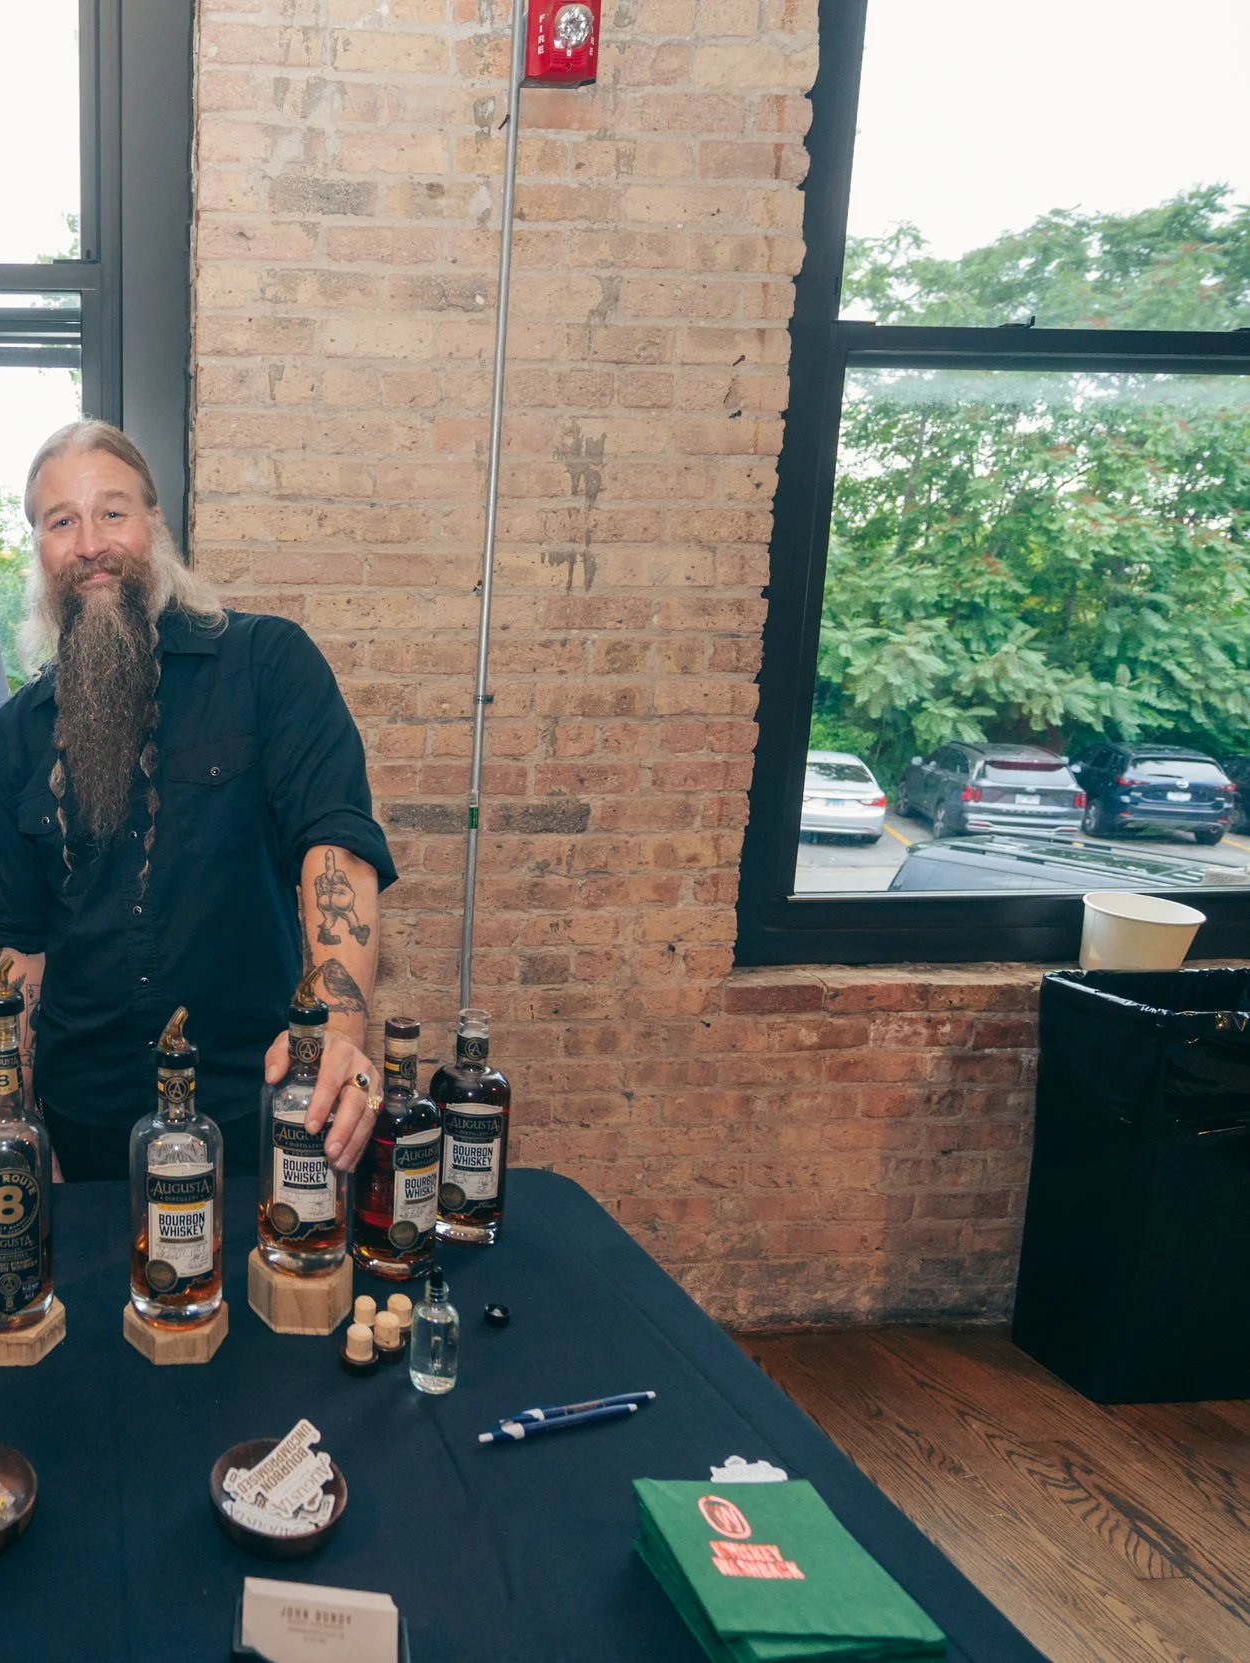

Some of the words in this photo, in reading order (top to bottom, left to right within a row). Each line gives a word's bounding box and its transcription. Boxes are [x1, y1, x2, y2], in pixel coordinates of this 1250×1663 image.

[537, 13, 546, 54] FIRE
[447, 1118, 502, 1132] AUGUSTA
[453, 1144, 493, 1157] BOURBON
[283, 1158, 329, 1173] BOURBON
[453, 1153, 492, 1167] WHISKEY
[283, 1170, 328, 1184] WHISKEY
[405, 1174, 437, 1190] BOURBON
[2, 1174, 37, 1196] ROUTE
[151, 1177, 212, 1197] AUGUSTA
[159, 1212, 205, 1227] BOURBON
[159, 1224, 205, 1238] WHISKEY
[237, 1422, 312, 1494] UNCOMPROMISED
[260, 1446, 309, 1494] BOURBON
[273, 1456, 331, 1516] AUGUSTA
